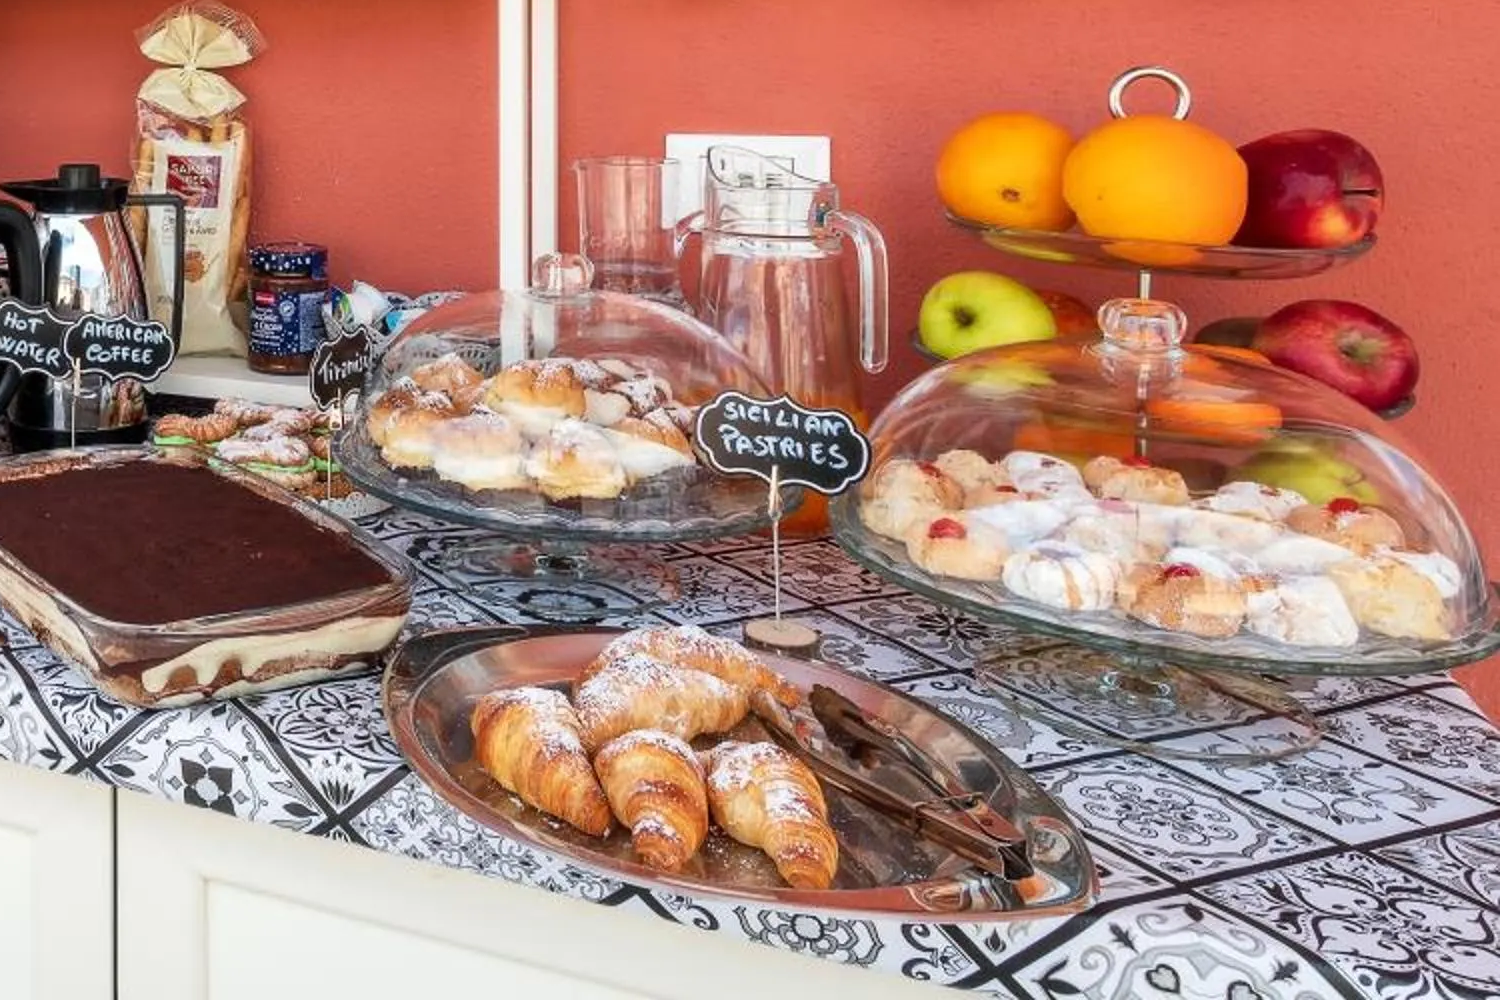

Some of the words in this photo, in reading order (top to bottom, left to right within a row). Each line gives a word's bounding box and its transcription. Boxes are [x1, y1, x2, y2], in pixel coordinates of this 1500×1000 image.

[82, 320, 165, 345] AMERICAN
[723, 401, 845, 437] SICILIAN
[717, 423, 849, 470] PASTRIES
